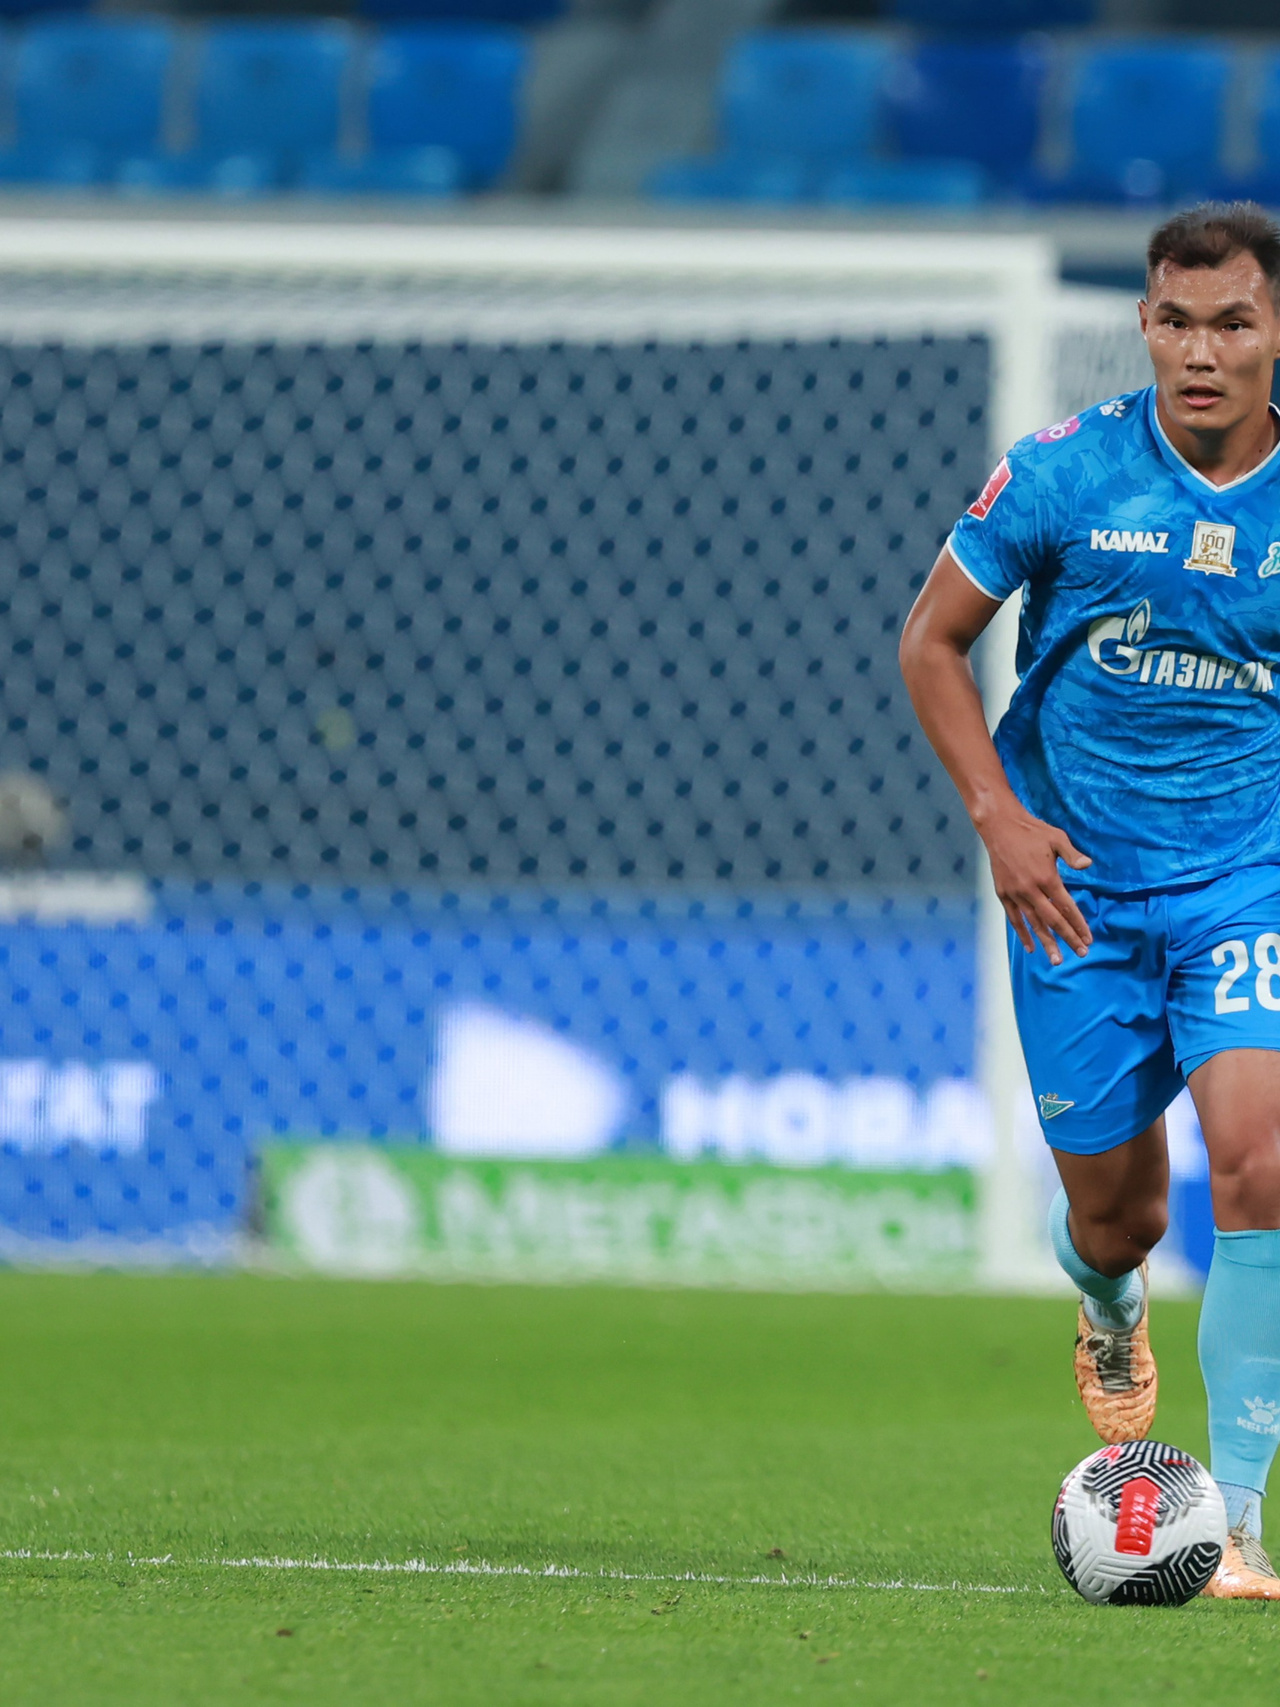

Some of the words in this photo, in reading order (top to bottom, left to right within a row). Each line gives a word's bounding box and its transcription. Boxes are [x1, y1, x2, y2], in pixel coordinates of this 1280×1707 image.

[1090, 529, 1168, 553] KAMAZ
[1201, 533, 1226, 550] 100
[1139, 650, 1277, 693] ГАЗПРОМ
